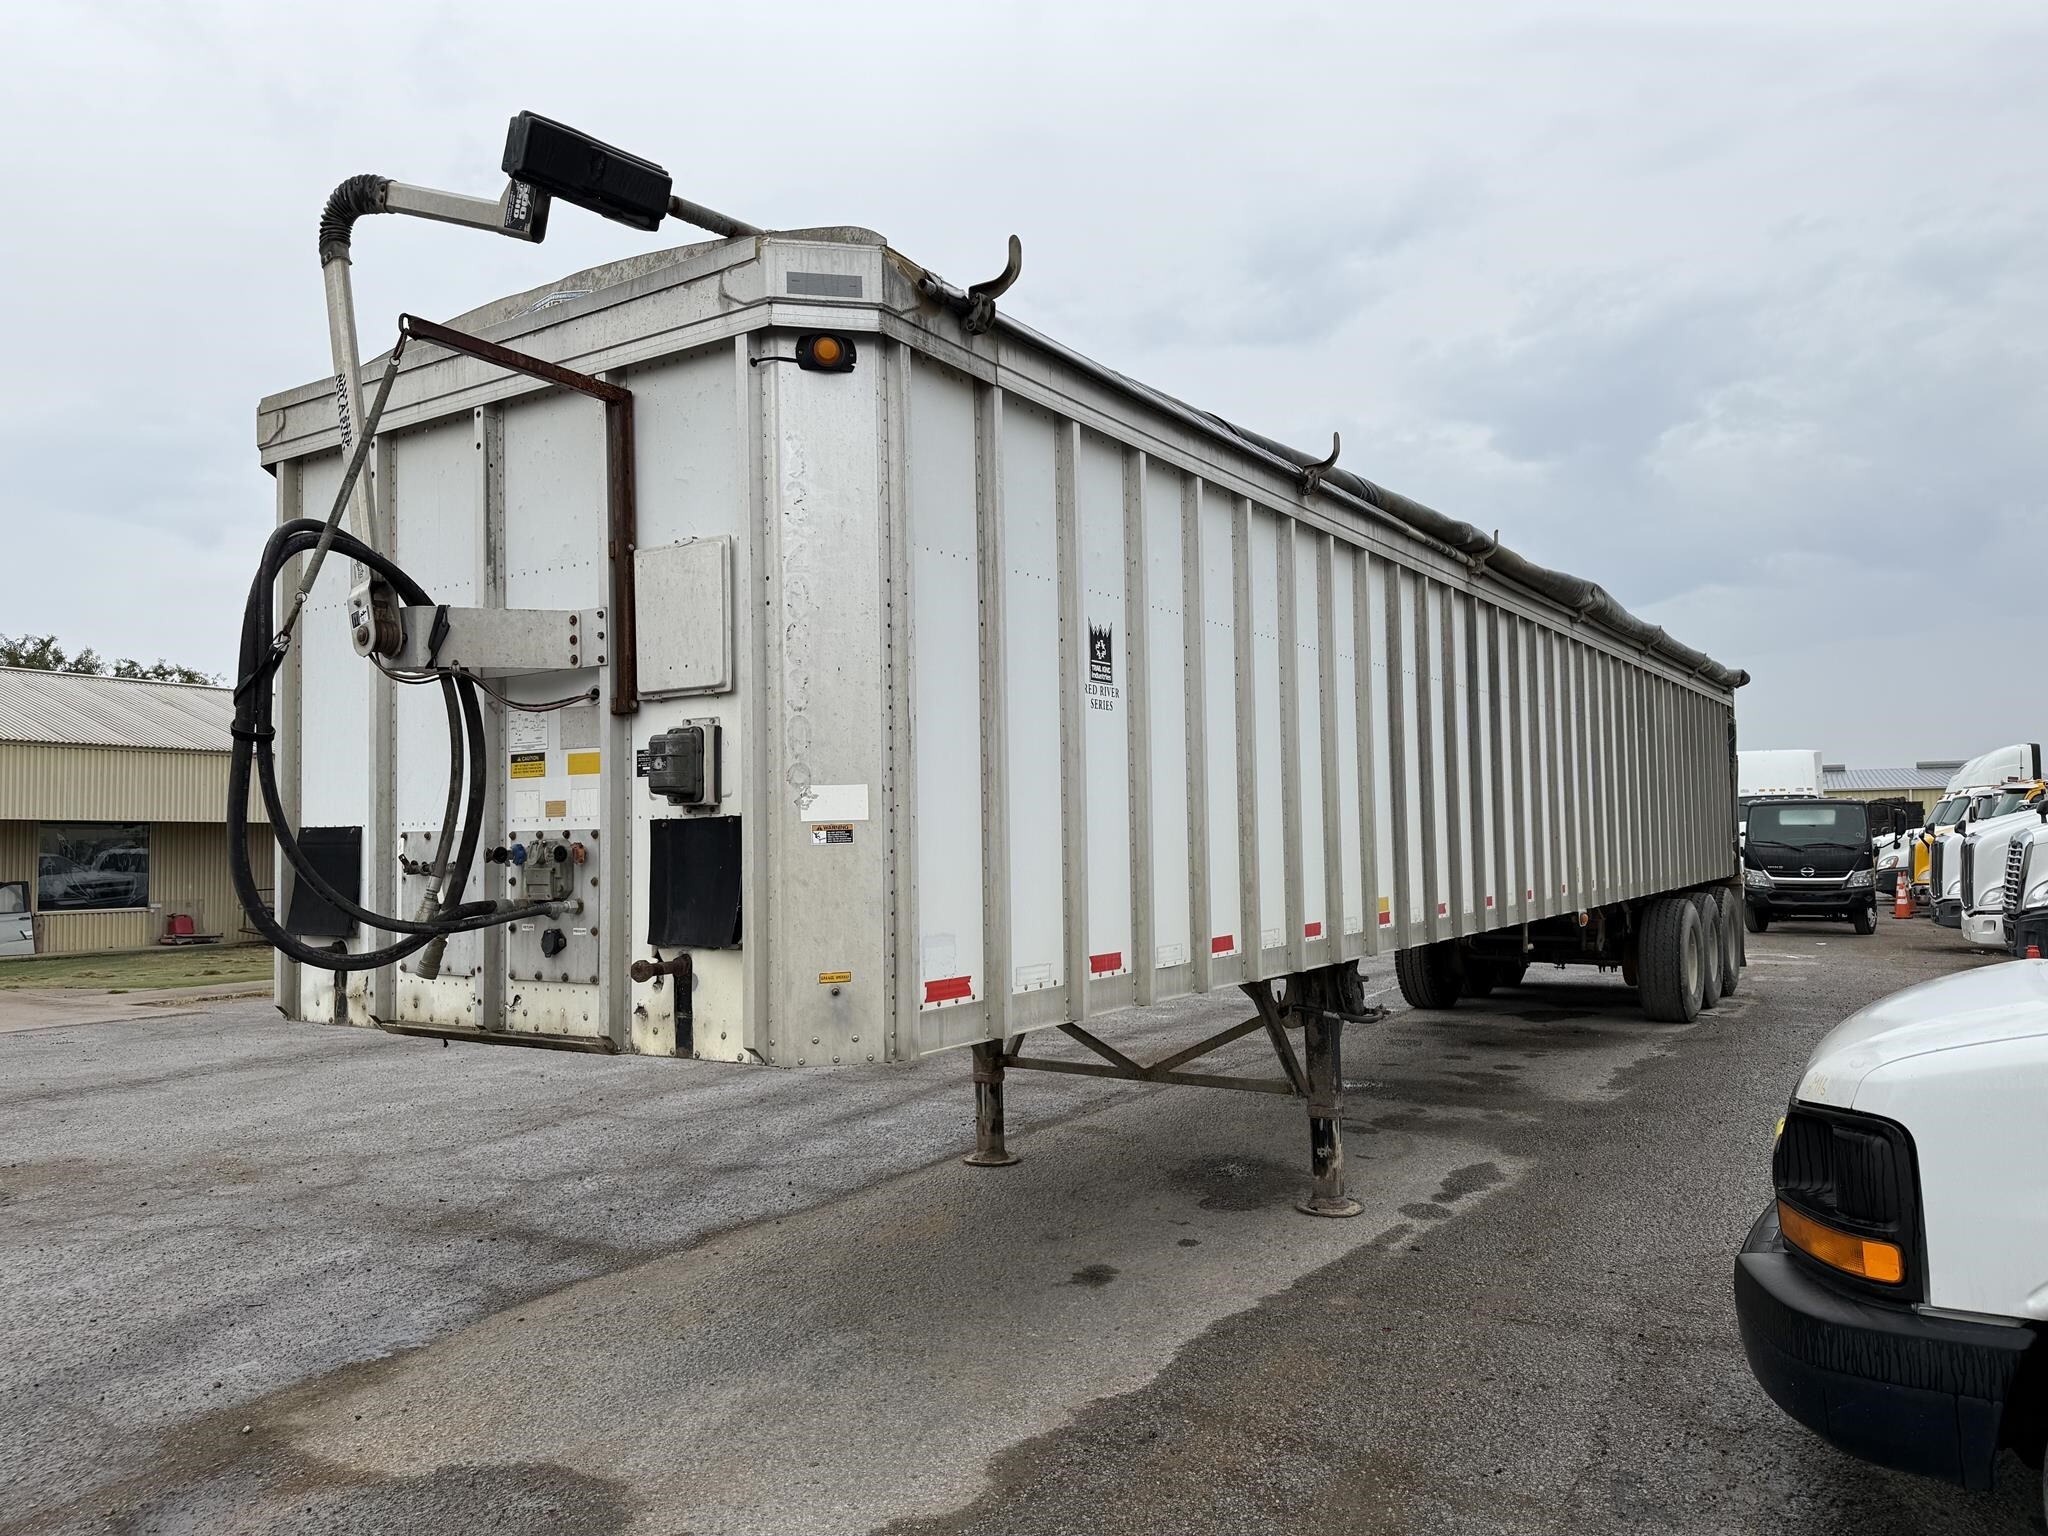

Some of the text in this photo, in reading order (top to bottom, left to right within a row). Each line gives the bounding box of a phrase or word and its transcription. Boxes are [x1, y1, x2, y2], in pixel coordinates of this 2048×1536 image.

[335, 373, 346, 399] NOT
[1100, 685, 1119, 698] RIVER
[1090, 698, 1113, 711] SERIES
